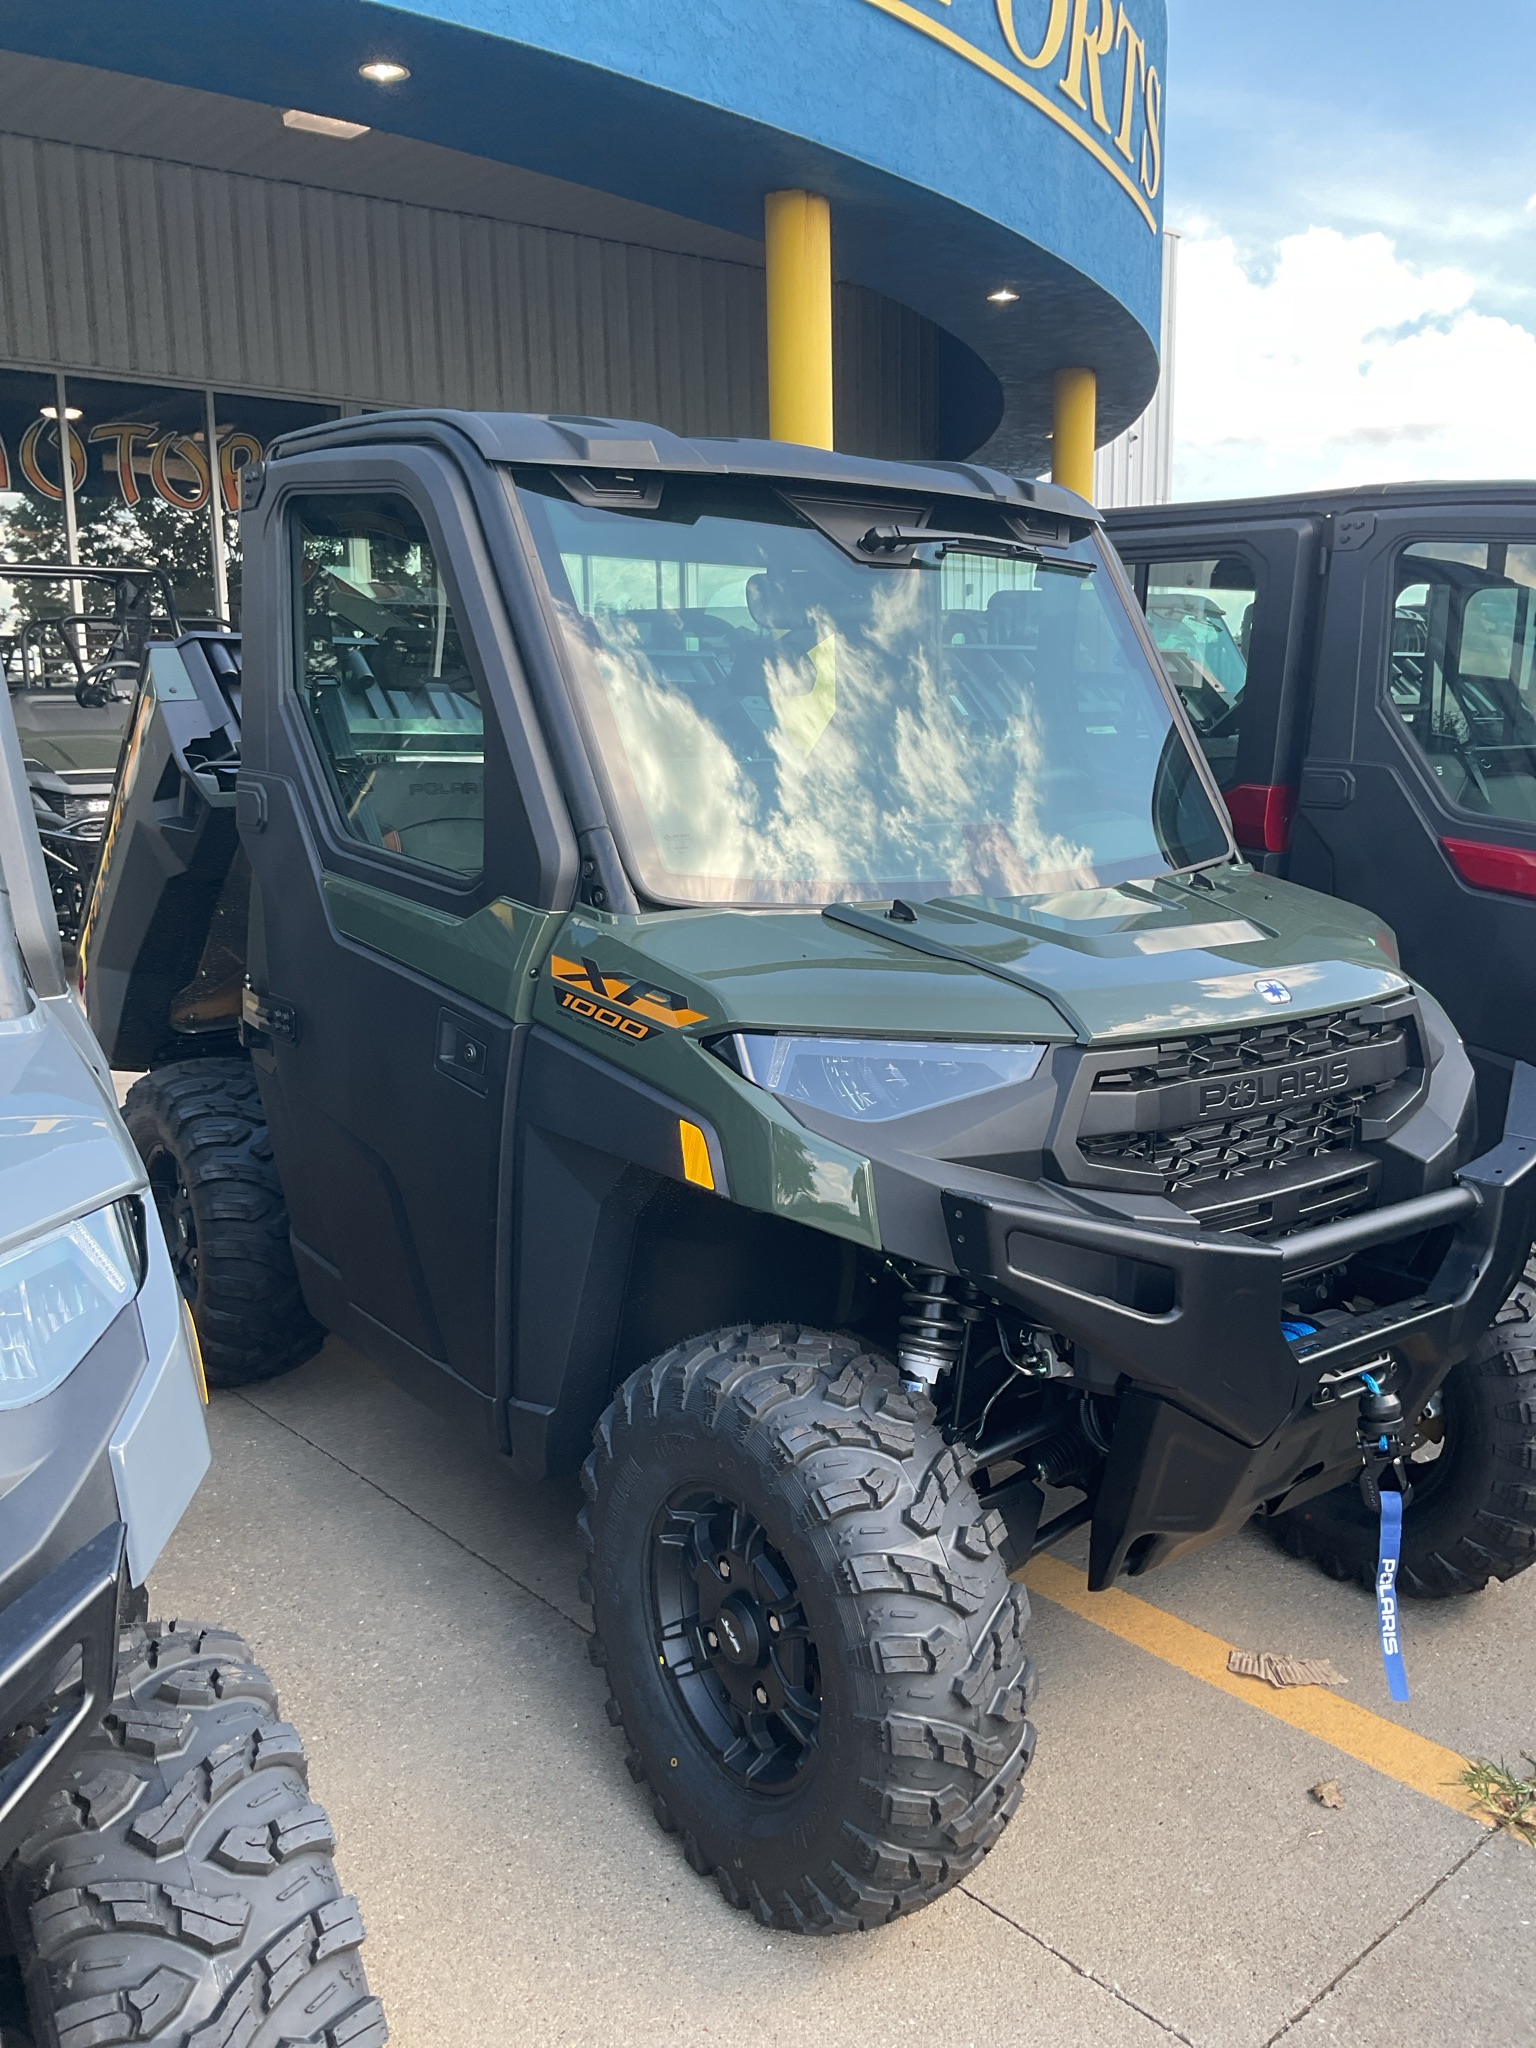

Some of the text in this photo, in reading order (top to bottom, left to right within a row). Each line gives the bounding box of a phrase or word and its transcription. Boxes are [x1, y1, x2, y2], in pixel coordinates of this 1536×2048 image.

[0, 416, 262, 515] OTOR
[555, 954, 689, 1012] XP
[561, 992, 649, 1040] 1000
[1199, 1058, 1349, 1116] POLARIS
[1378, 1558, 1399, 1656] POLARIS
